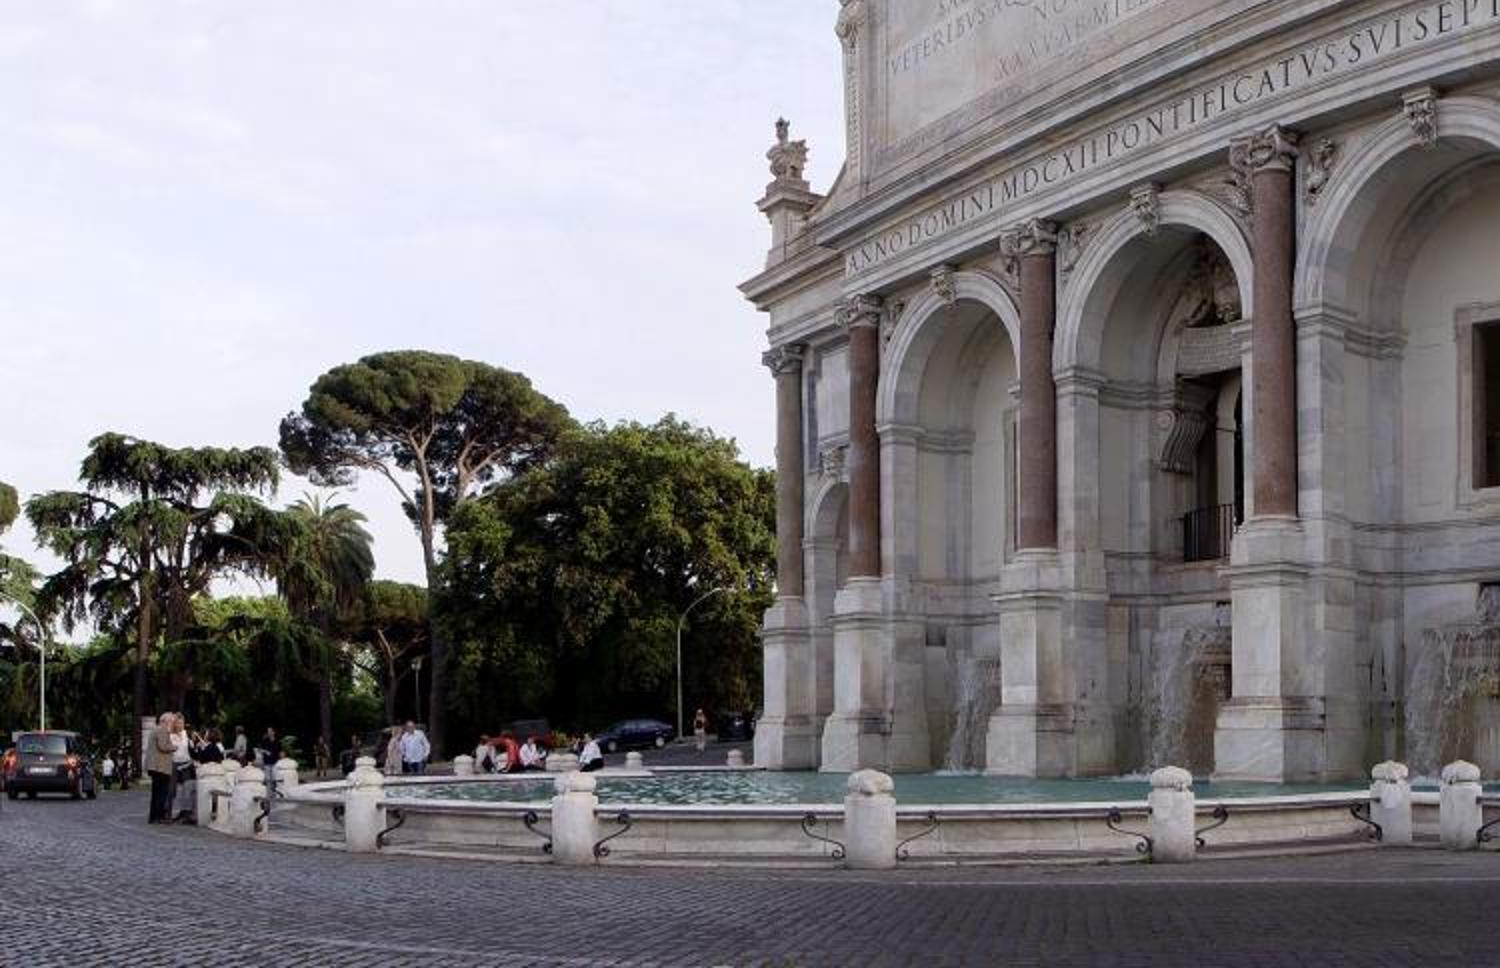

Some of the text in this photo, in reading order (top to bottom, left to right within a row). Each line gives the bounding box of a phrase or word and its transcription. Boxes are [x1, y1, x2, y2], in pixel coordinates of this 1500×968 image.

[849, 229, 906, 272] ANNO
[907, 186, 995, 245] DOMINI
[999, 143, 1099, 201] MDCXII
[1105, 42, 1337, 158] PONTIFICATVS
[1347, 18, 1401, 64] SVI
